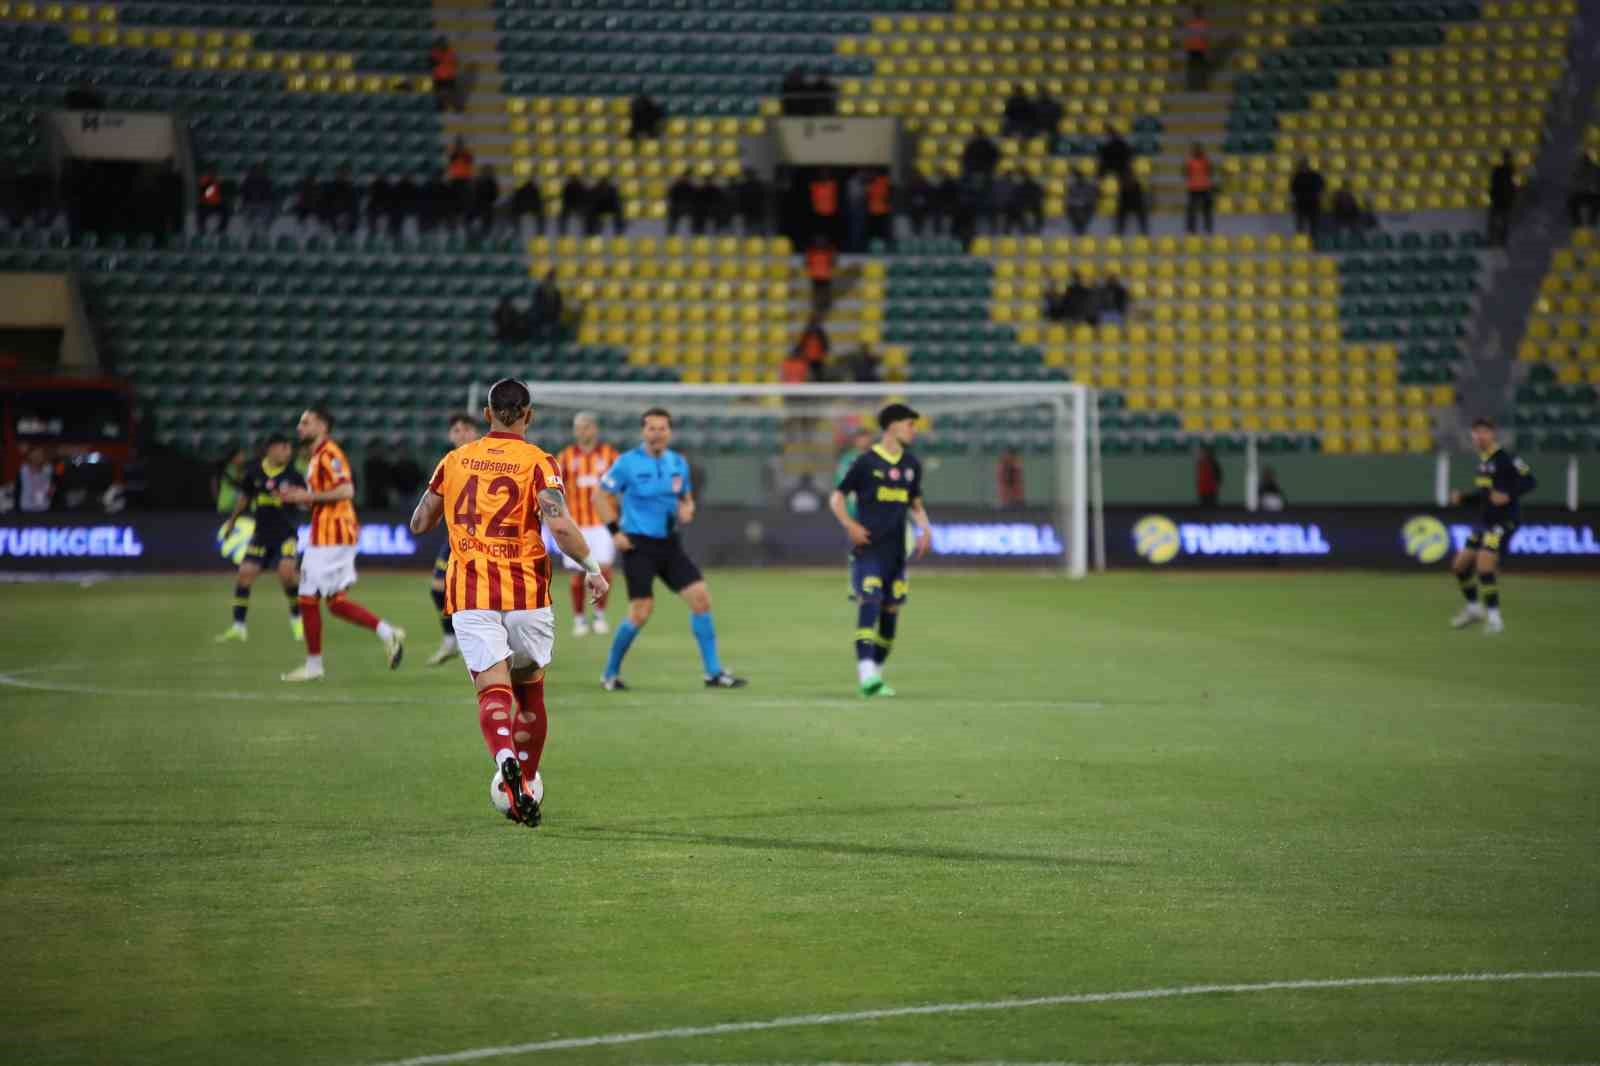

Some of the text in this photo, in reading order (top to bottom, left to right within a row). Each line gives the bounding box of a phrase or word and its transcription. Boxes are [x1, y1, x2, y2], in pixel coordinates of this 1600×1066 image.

[453, 475, 521, 538] 42
[930, 523, 1062, 556] URKCELL
[1181, 523, 1331, 555] TURKCELL
[1450, 524, 1600, 555] TKCELL
